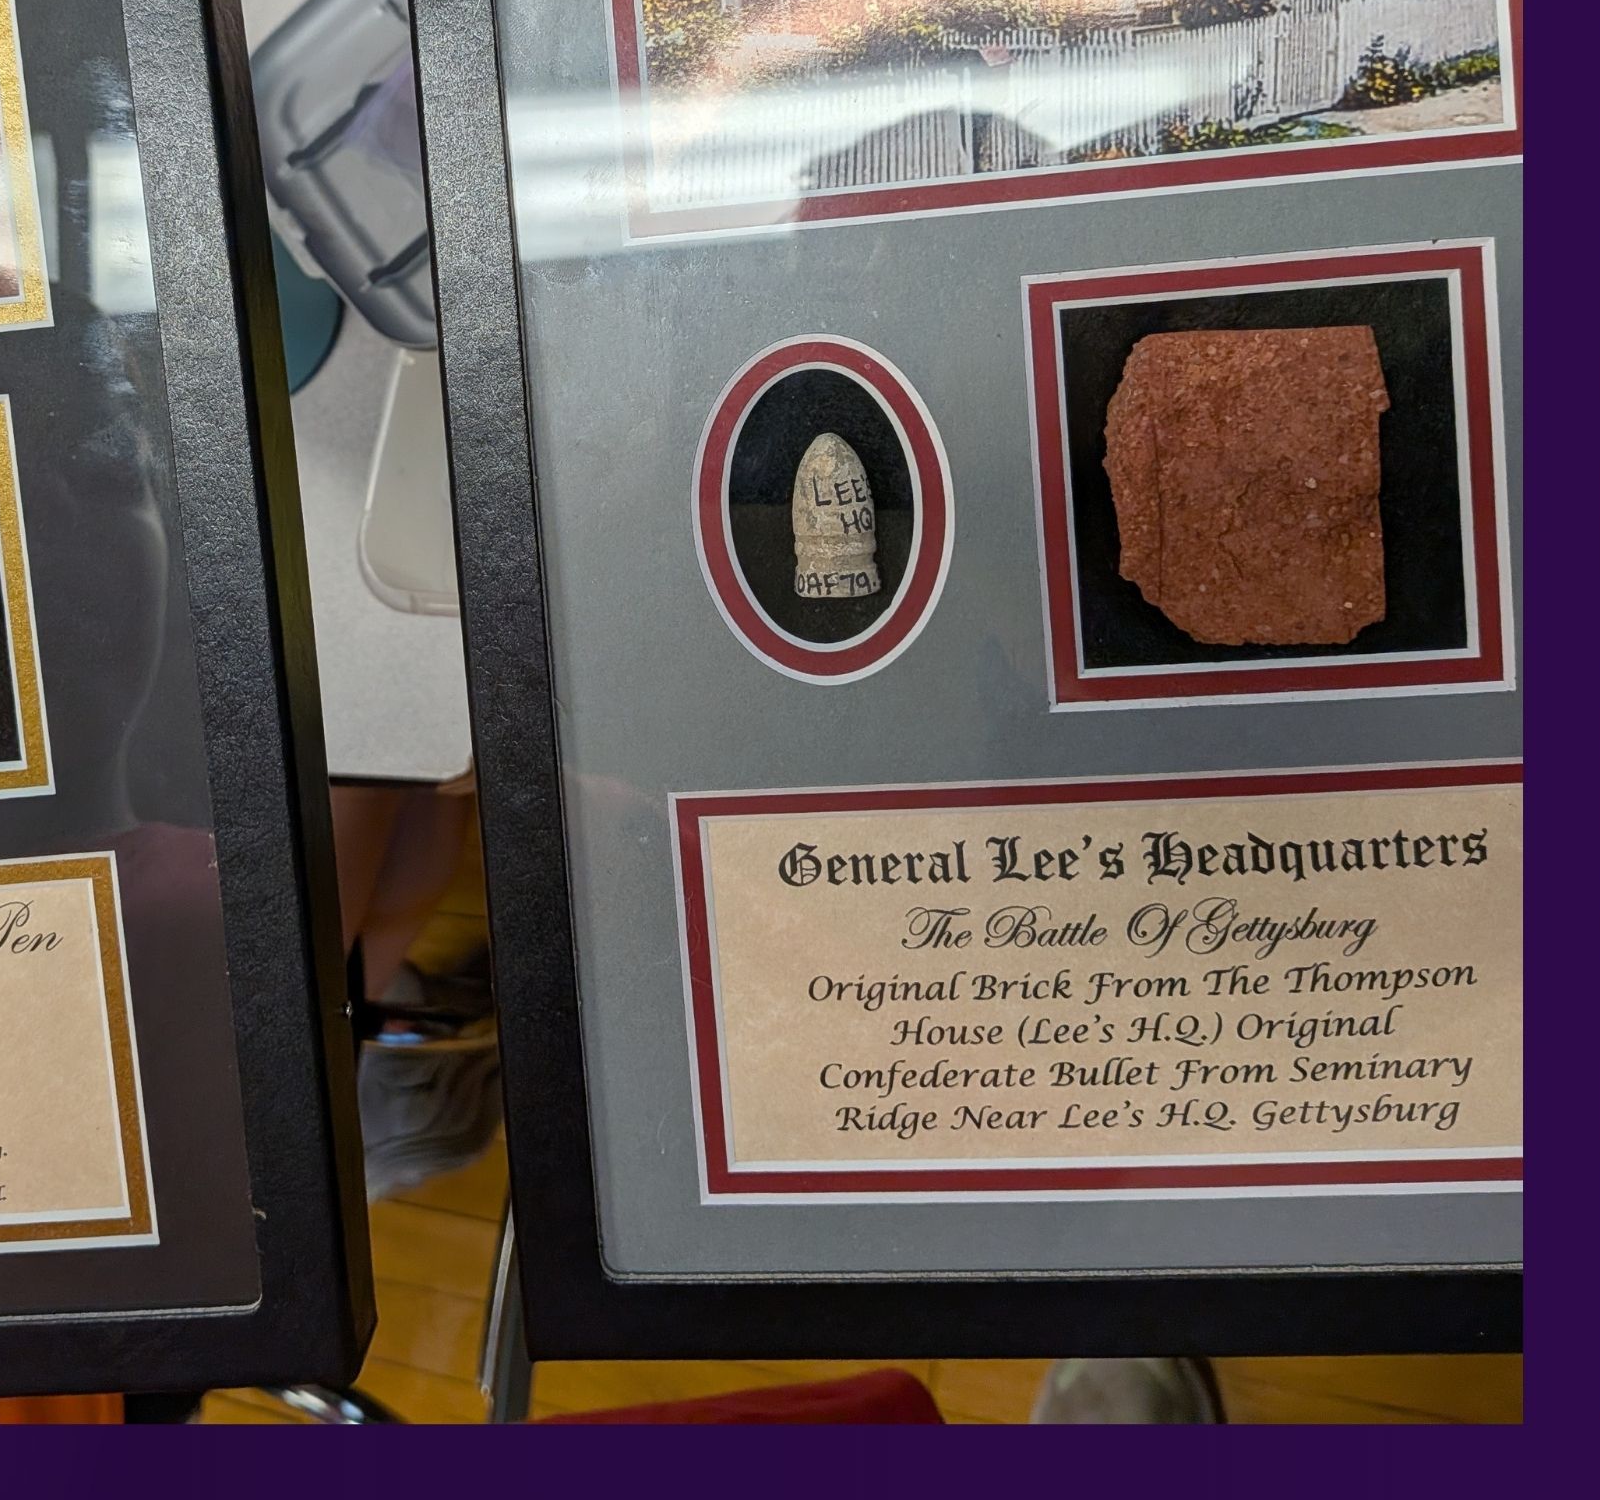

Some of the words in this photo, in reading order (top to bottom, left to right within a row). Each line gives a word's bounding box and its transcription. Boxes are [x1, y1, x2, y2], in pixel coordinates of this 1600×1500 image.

[778, 840, 971, 887] General
[984, 836, 1127, 883] Lee's
[1140, 827, 1490, 887] Headquarters
[901, 906, 972, 950] The
[983, 904, 1107, 949] Battle
[1126, 902, 1183, 959] Of
[1186, 897, 1379, 956] Gettysburg
[808, 970, 967, 1012] Original
[971, 969, 1073, 1001] Brick
[1083, 972, 1191, 1005] From
[1202, 964, 1270, 996] The
[1283, 961, 1478, 1001] Thompson
[889, 1015, 1003, 1046] House
[1017, 1013, 1115, 1049] (Lee's
[1126, 1011, 1223, 1047] H.Q.)
[1236, 1004, 1404, 1049] Original
[819, 1059, 1036, 1099] Confederate
[1049, 1056, 1161, 1087] Bullet
[1169, 1059, 1278, 1091] From
[1288, 1052, 1473, 1087] Seminary
[835, 1102, 938, 1140] Ridge
[949, 1105, 1048, 1131] Near
[1057, 1100, 1144, 1129] Lee's
[1155, 1098, 1237, 1132] H.Q.
[1252, 1093, 1461, 1134] Gettysburg
